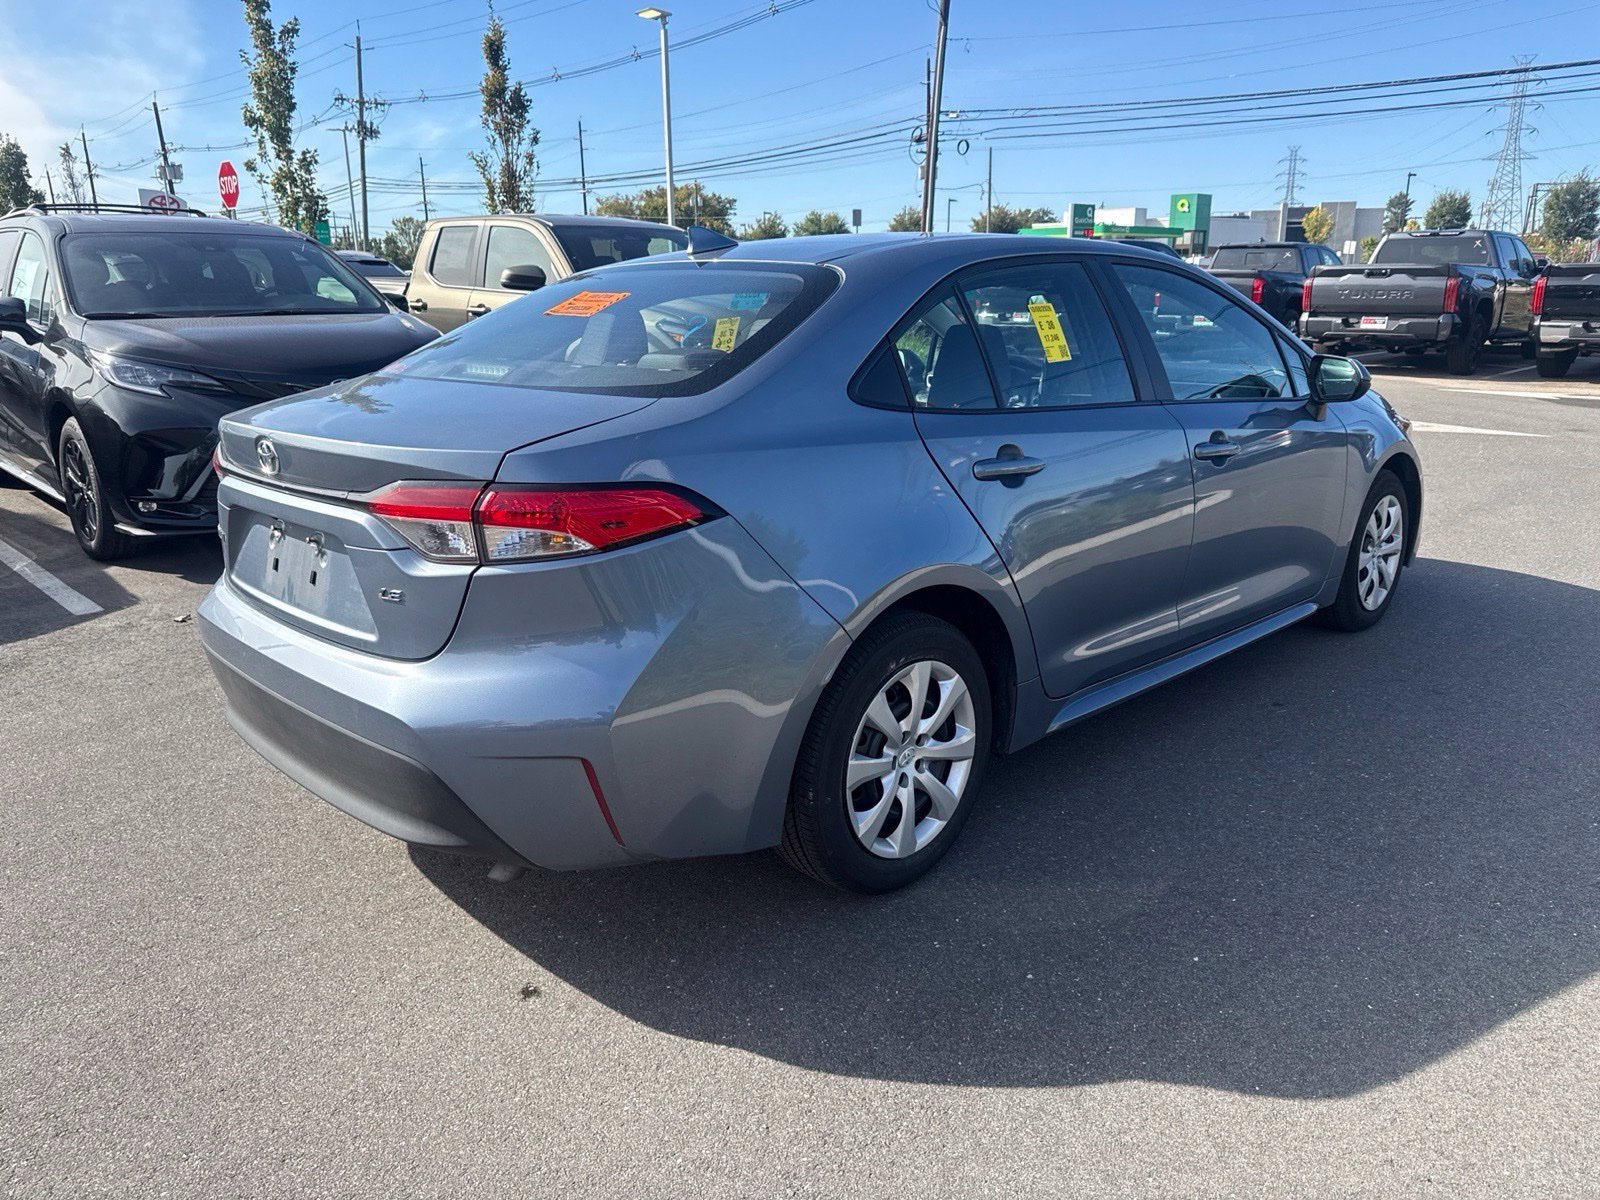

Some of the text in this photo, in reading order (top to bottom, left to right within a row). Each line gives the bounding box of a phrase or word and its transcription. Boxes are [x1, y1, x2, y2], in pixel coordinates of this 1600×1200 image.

[220, 175, 237, 195] STOP
[1338, 289, 1414, 299] TUNDRA
[1038, 320, 1055, 331] E 38
[378, 587, 402, 601] LE
